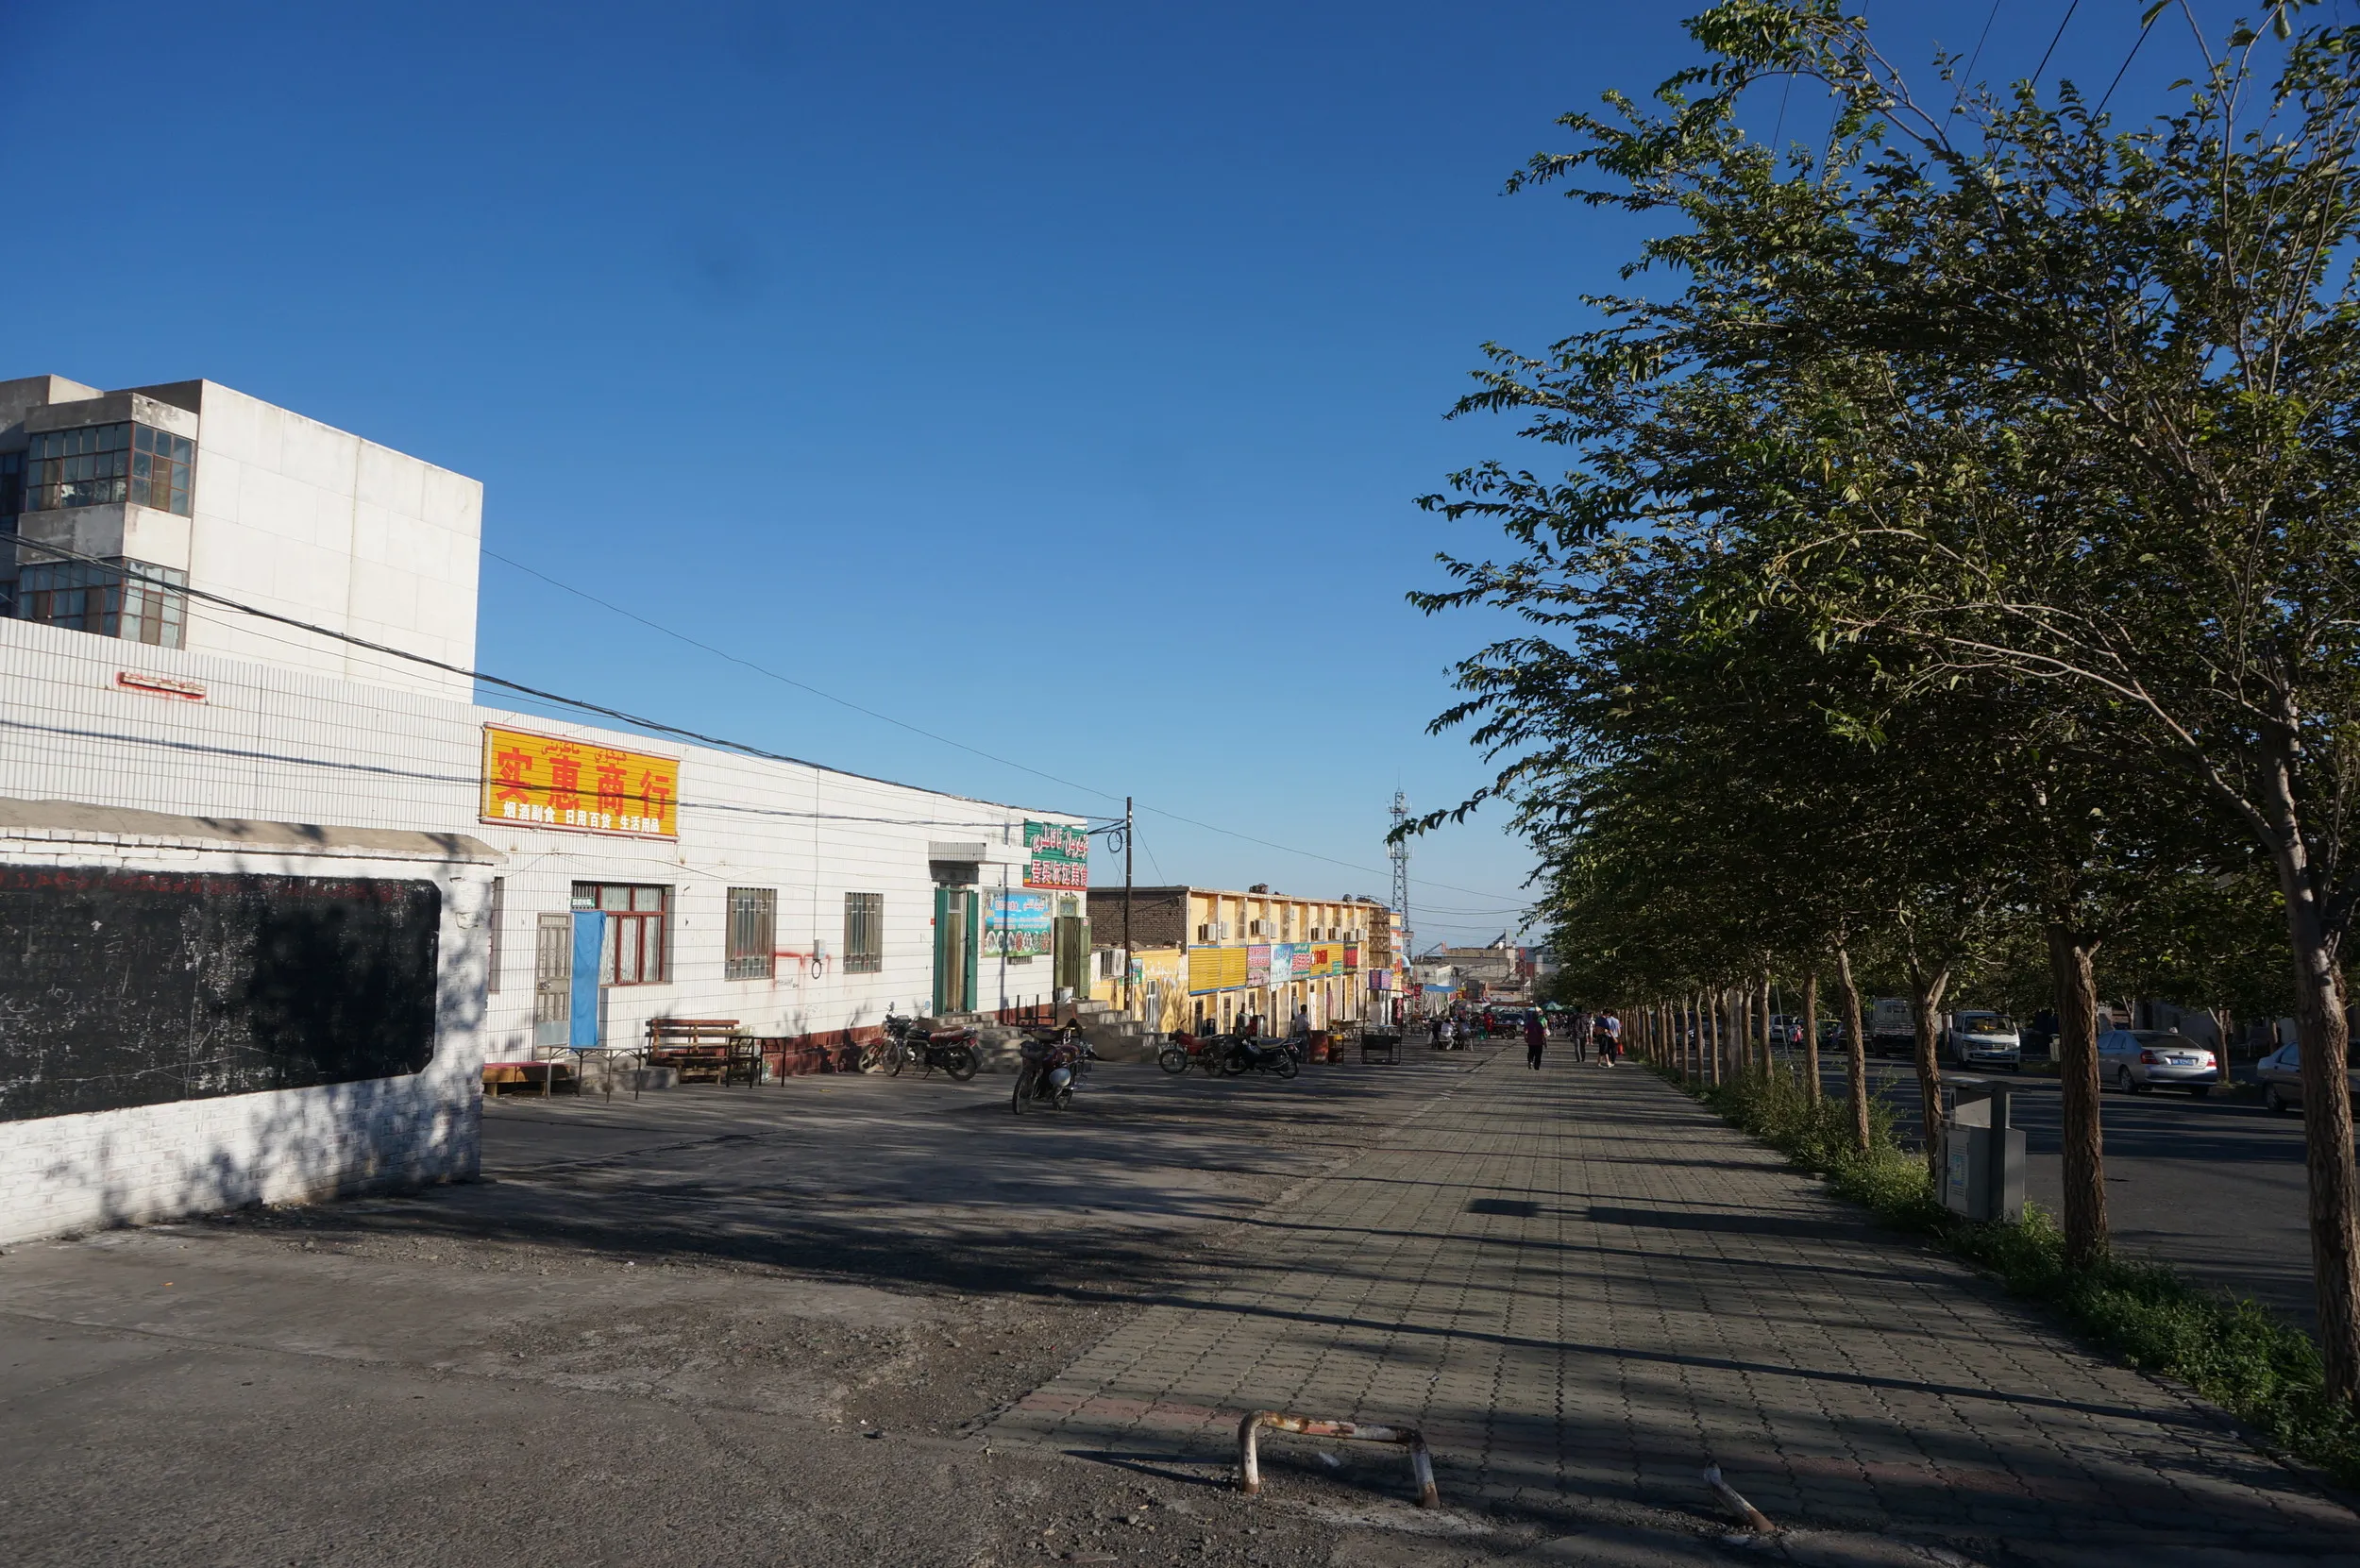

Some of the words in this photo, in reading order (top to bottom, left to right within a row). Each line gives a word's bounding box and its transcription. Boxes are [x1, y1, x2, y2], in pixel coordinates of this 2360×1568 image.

[496, 747, 670, 820] 实惠商行
[503, 801, 555, 823] 烟酒副食
[565, 809, 612, 829] 日用百货
[619, 815, 660, 833] 生活用品
